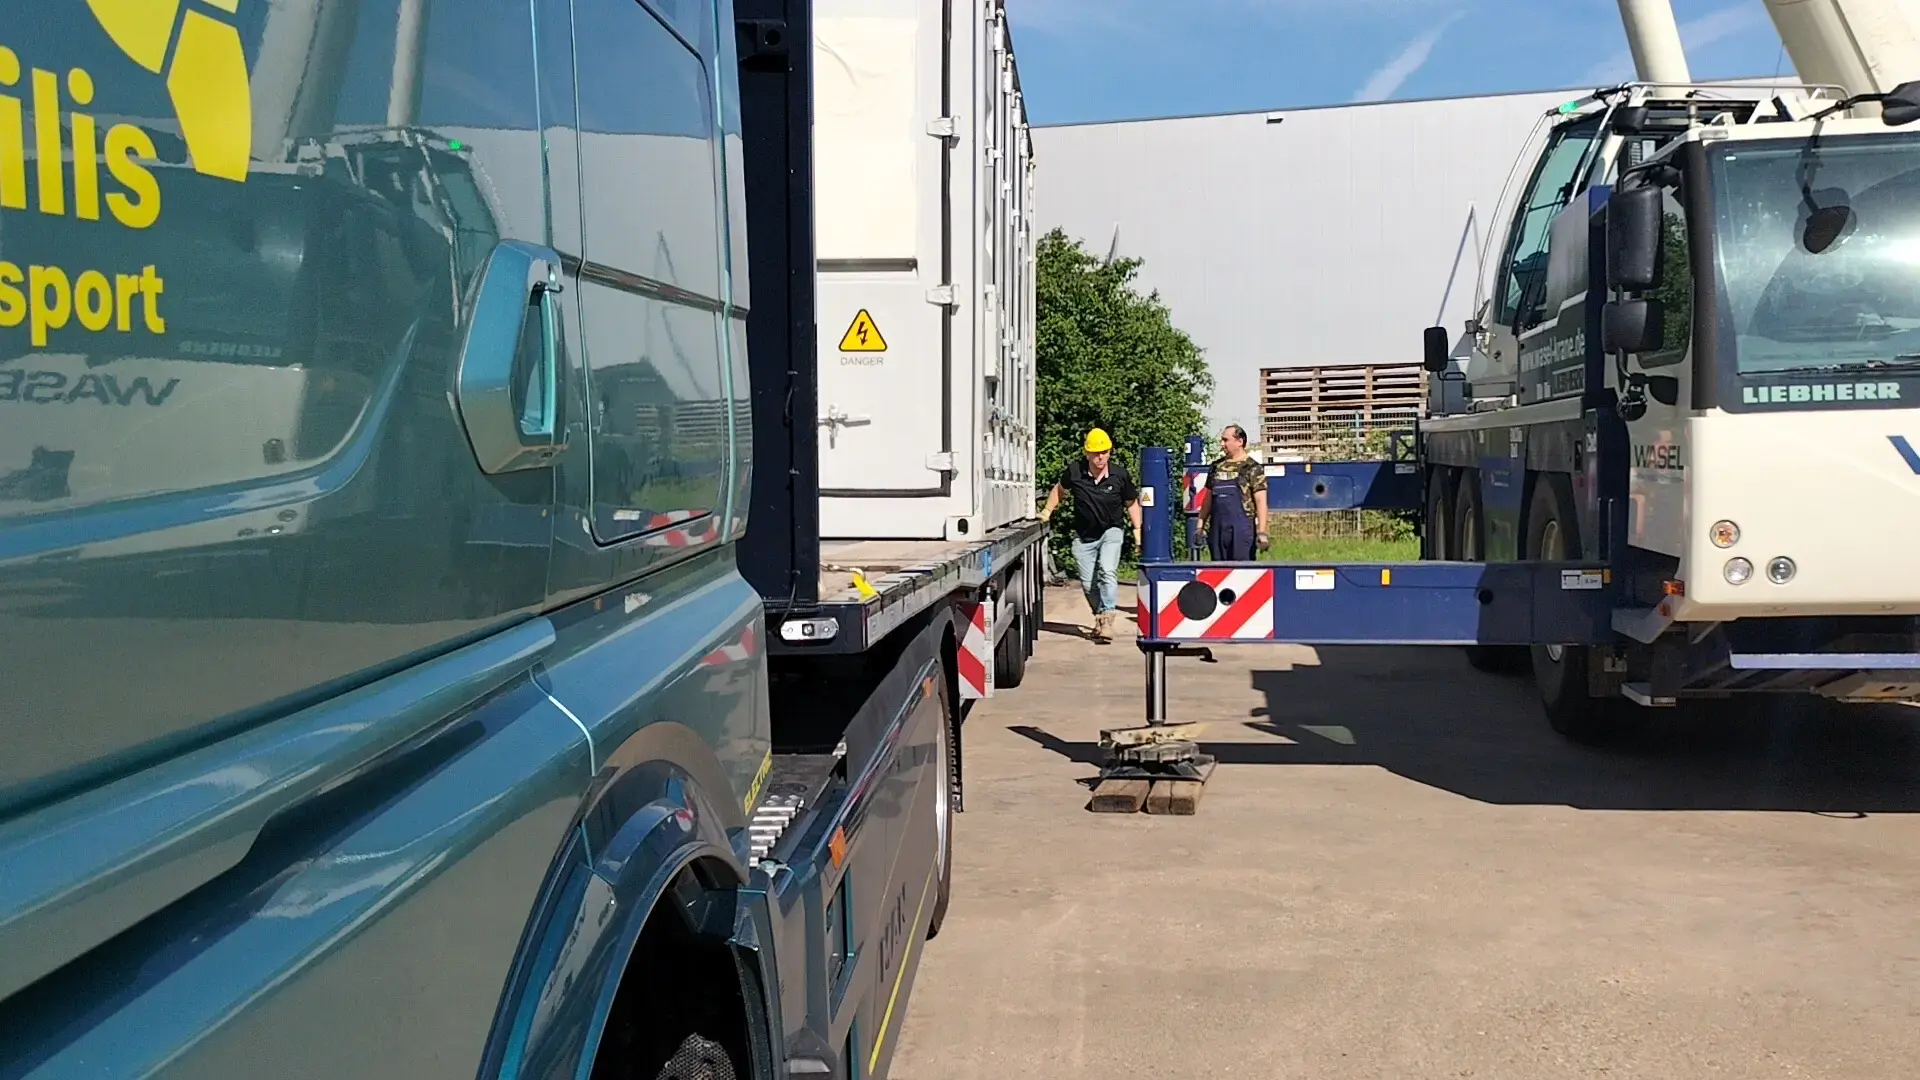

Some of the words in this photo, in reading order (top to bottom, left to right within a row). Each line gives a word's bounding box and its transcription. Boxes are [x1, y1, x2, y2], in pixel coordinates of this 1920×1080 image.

[0, 46, 161, 228] ilis
[0, 261, 165, 346] sport
[840, 356, 884, 366] DANGER
[1743, 382, 1901, 404] LIEBHERR
[1634, 444, 1685, 470] WASEL
